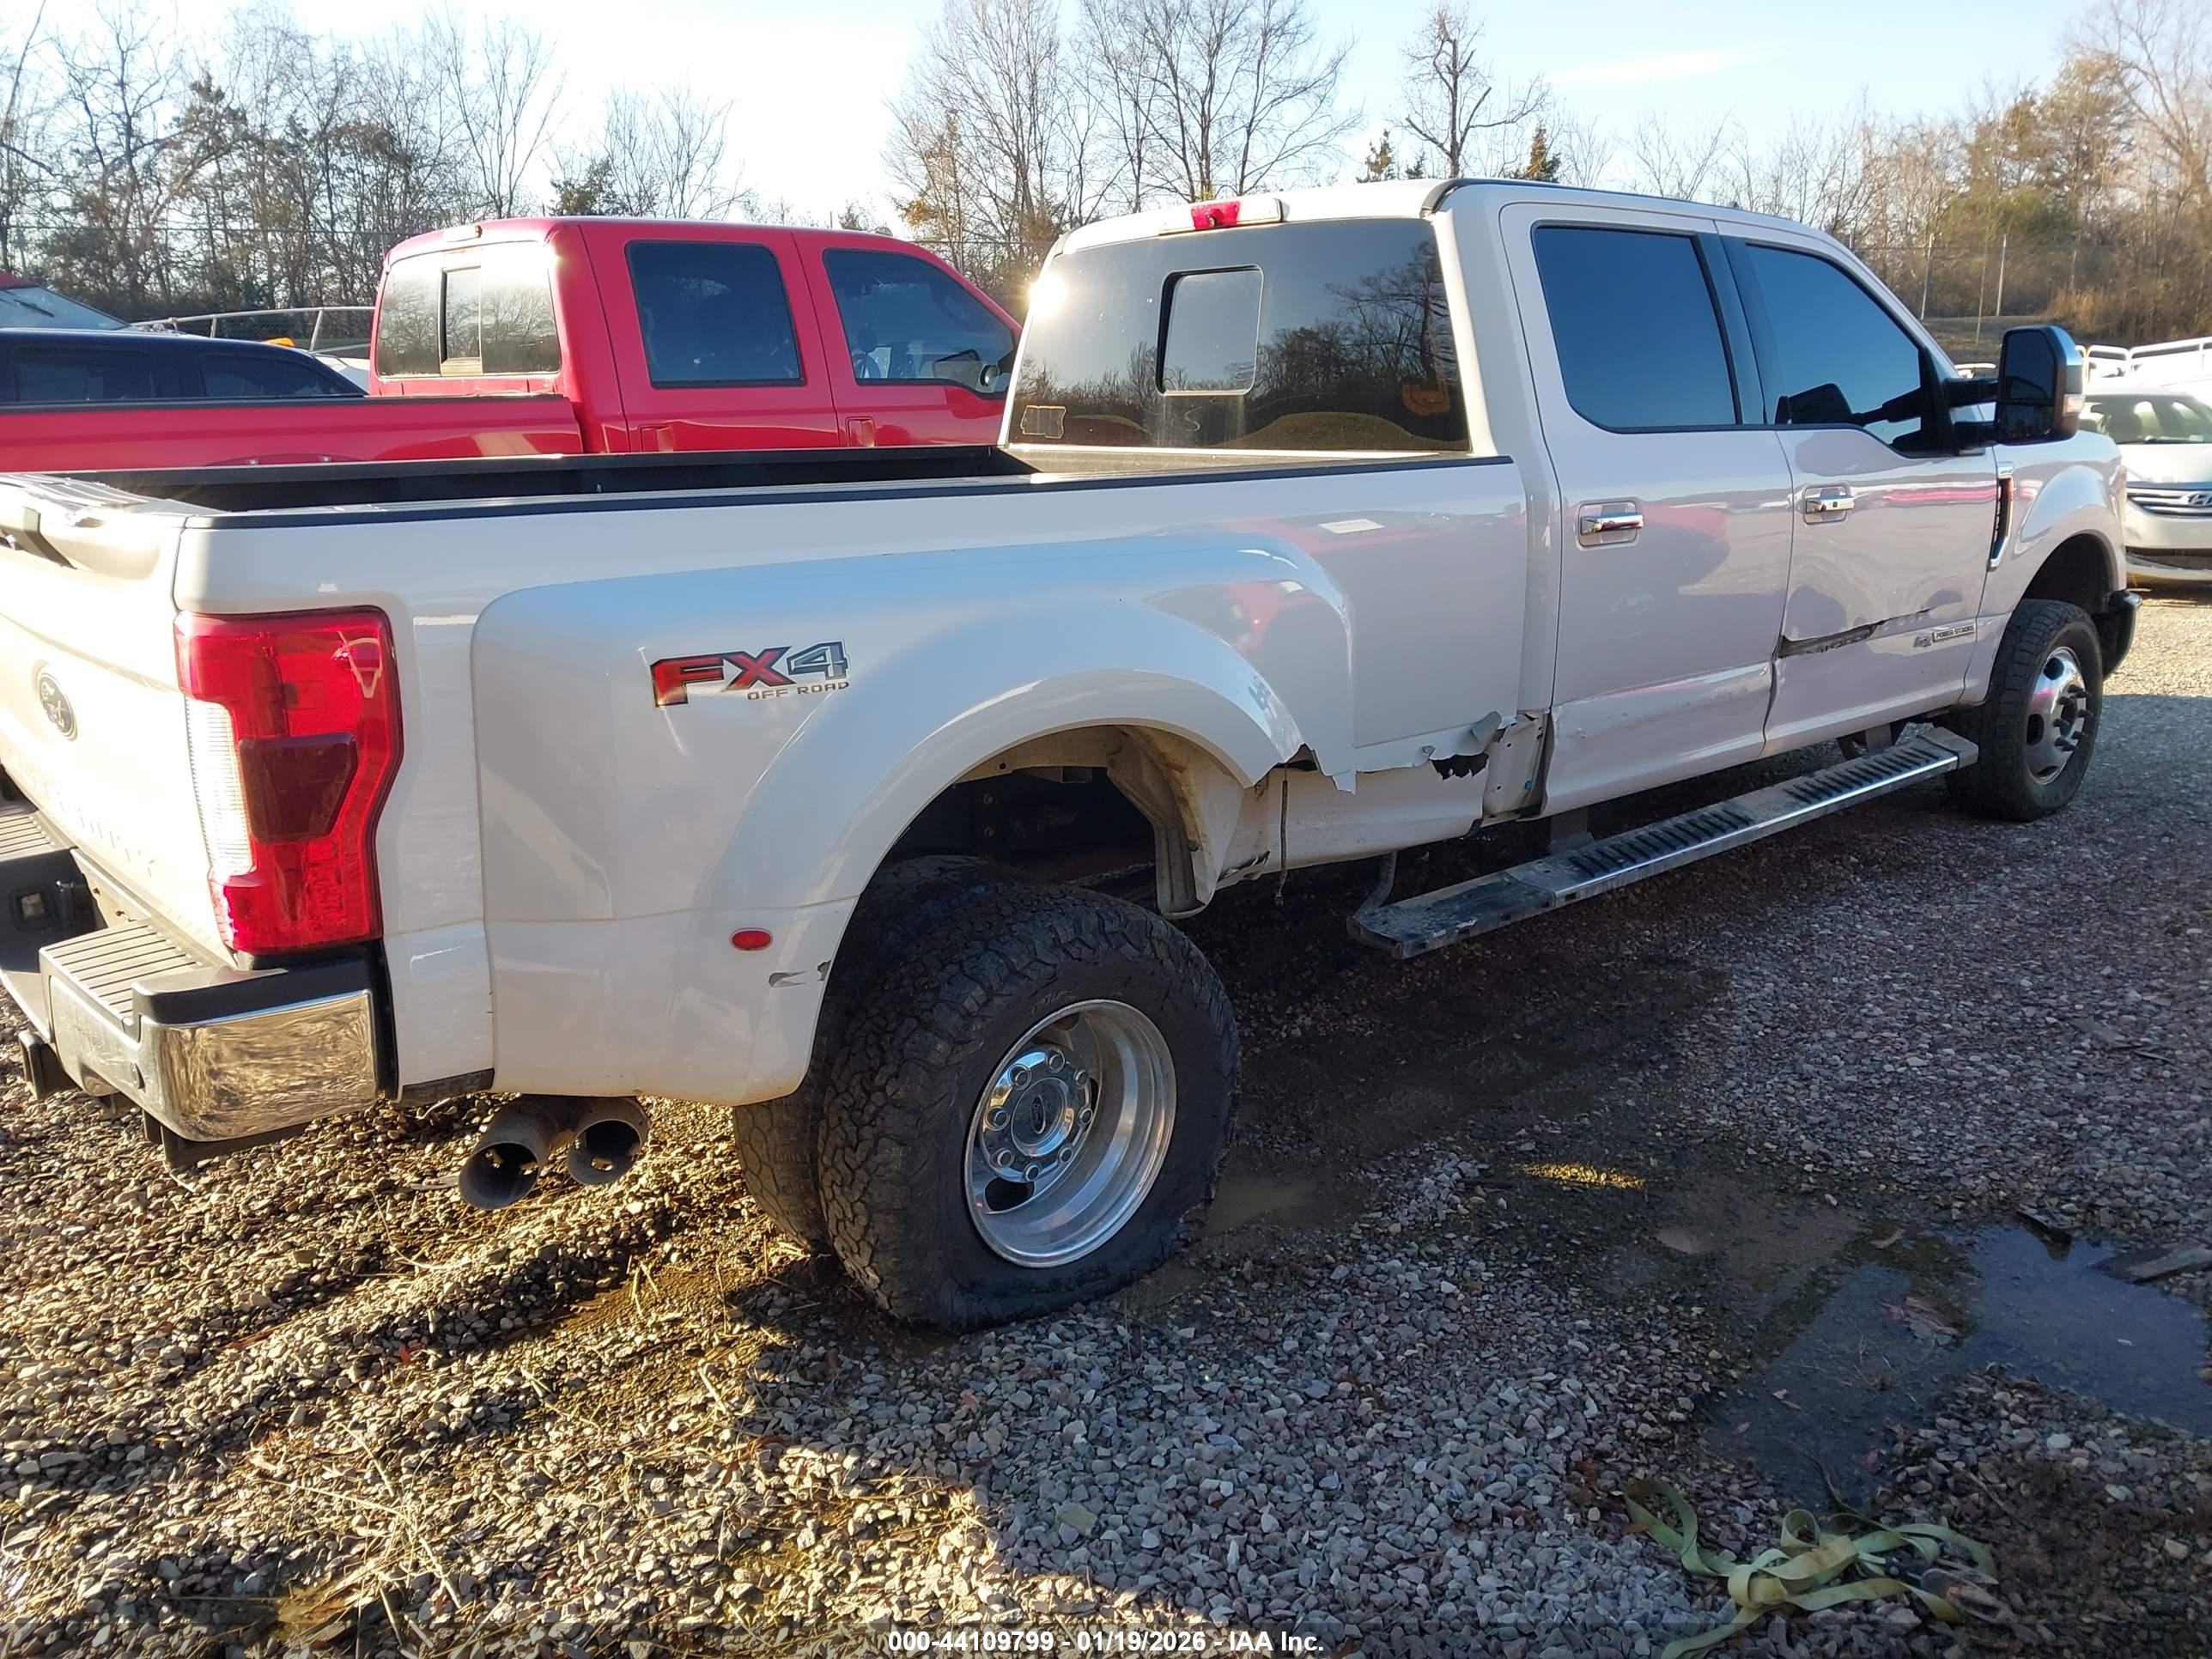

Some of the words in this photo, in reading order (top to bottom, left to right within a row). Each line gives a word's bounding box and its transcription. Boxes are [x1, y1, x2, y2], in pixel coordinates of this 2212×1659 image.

[650, 641, 849, 708] FX4
[747, 688, 789, 701] OFF
[797, 682, 849, 696] ROAD
